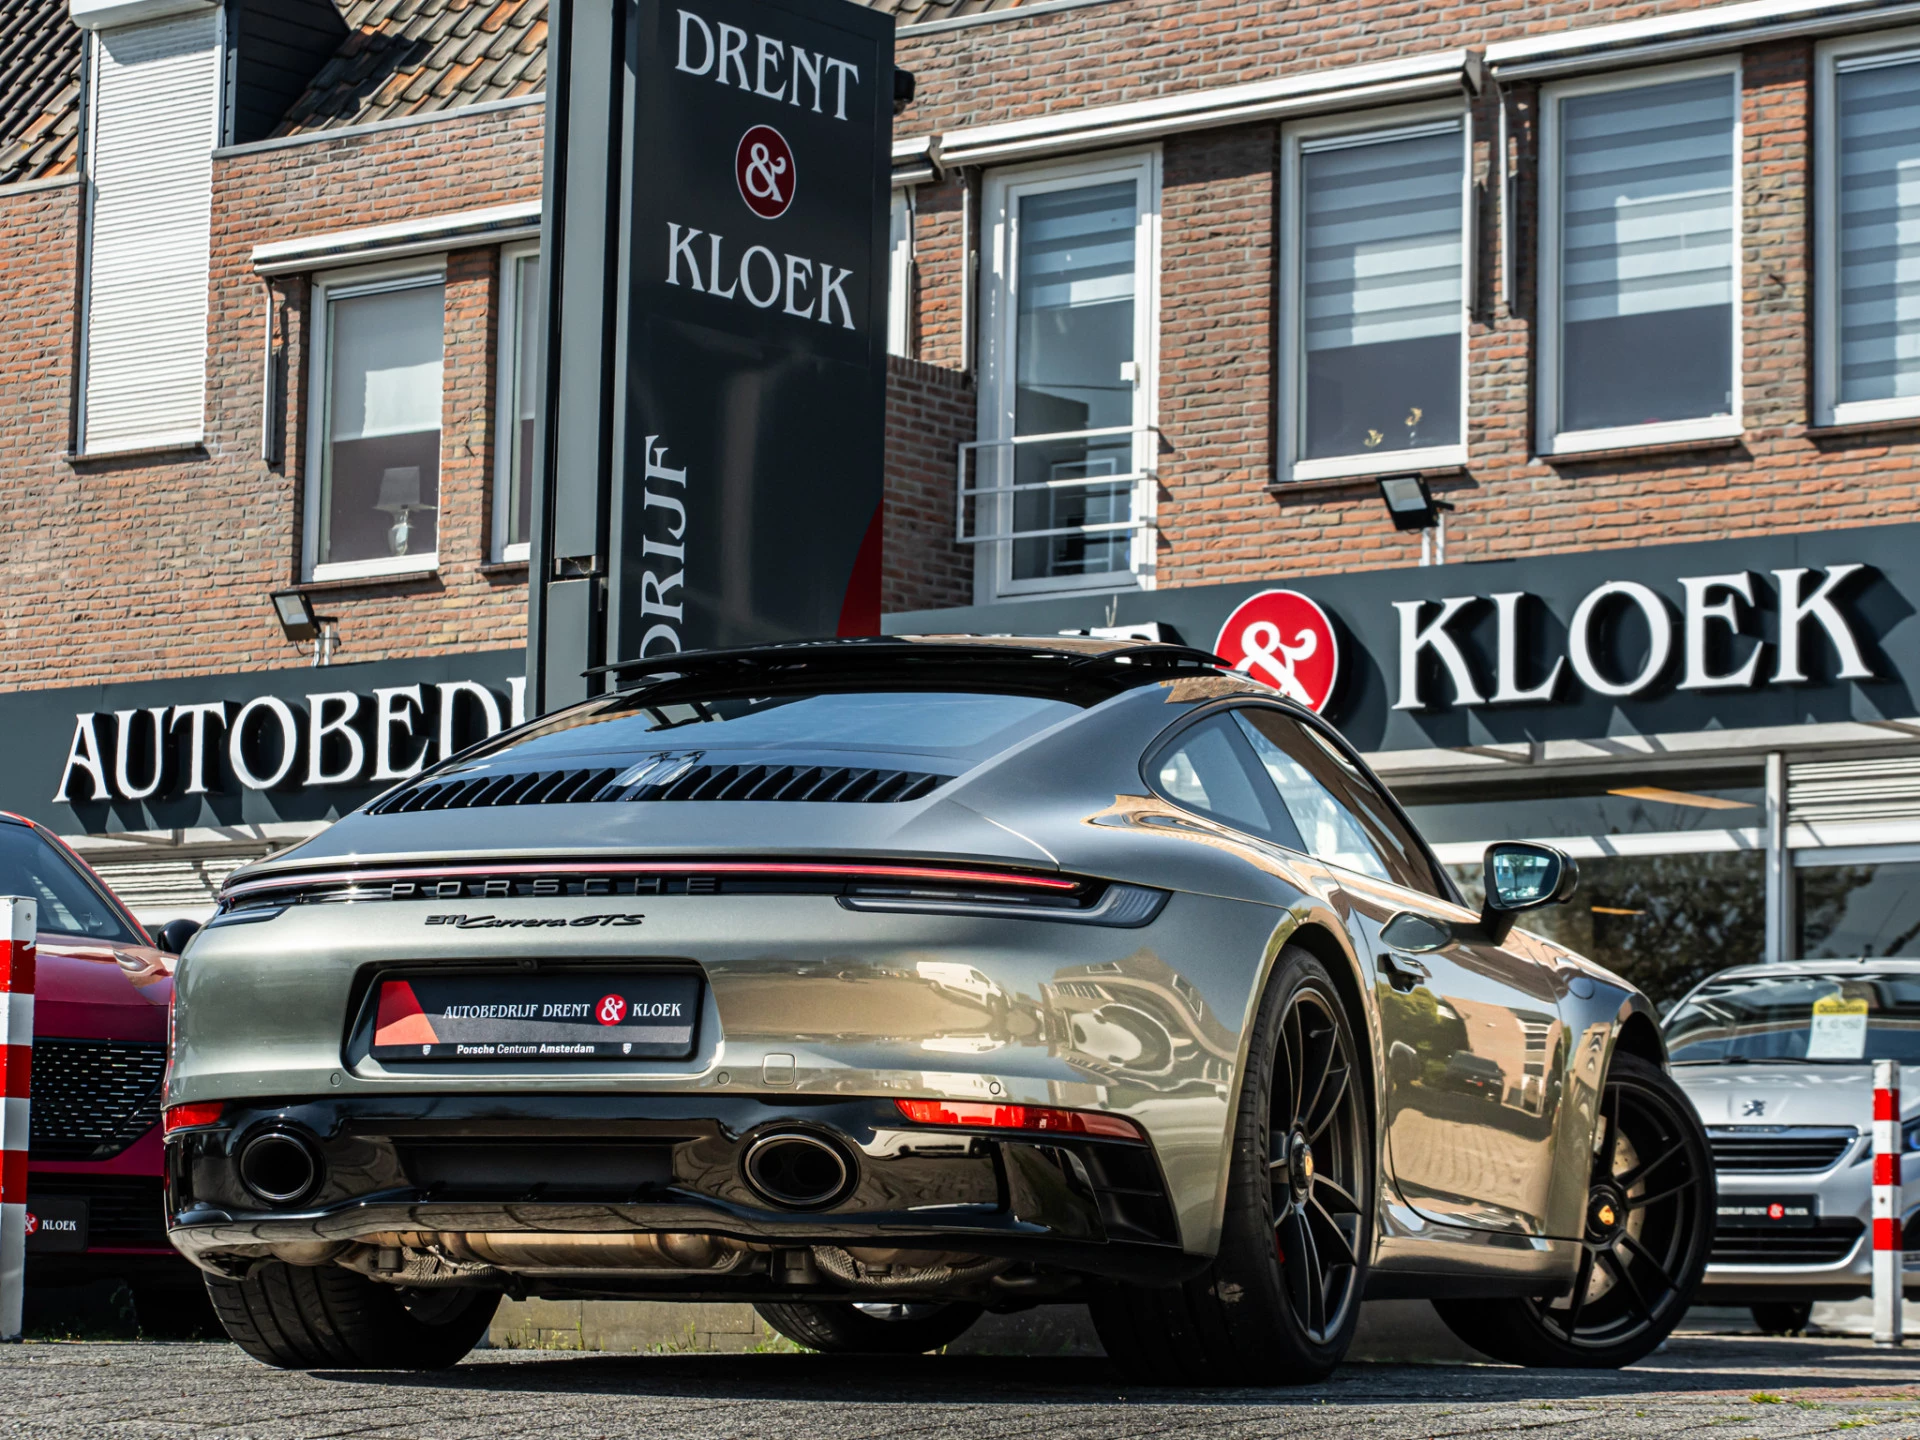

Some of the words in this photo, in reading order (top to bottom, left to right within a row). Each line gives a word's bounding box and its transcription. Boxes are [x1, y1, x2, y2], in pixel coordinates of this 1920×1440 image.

[674, 8, 860, 121] DRENT
[745, 142, 787, 203] &
[664, 221, 856, 331] KLOEK
[1234, 620, 1318, 705] &
[1391, 562, 1875, 710] KLOEK
[390, 877, 716, 899] PORSCHE
[424, 913, 468, 926] 911
[455, 914, 568, 929] Carrera
[568, 913, 646, 927] GTS
[442, 1003, 539, 1019] AUTOBEDRIJF
[541, 1003, 591, 1018] DRENT
[600, 997, 624, 1022] &
[632, 1002, 682, 1017] KLOEK
[456, 1044, 495, 1055] Porsche
[497, 1043, 537, 1054] Centrum
[539, 1043, 595, 1054] Amsterdam
[42, 1219, 77, 1231] KLOEK
